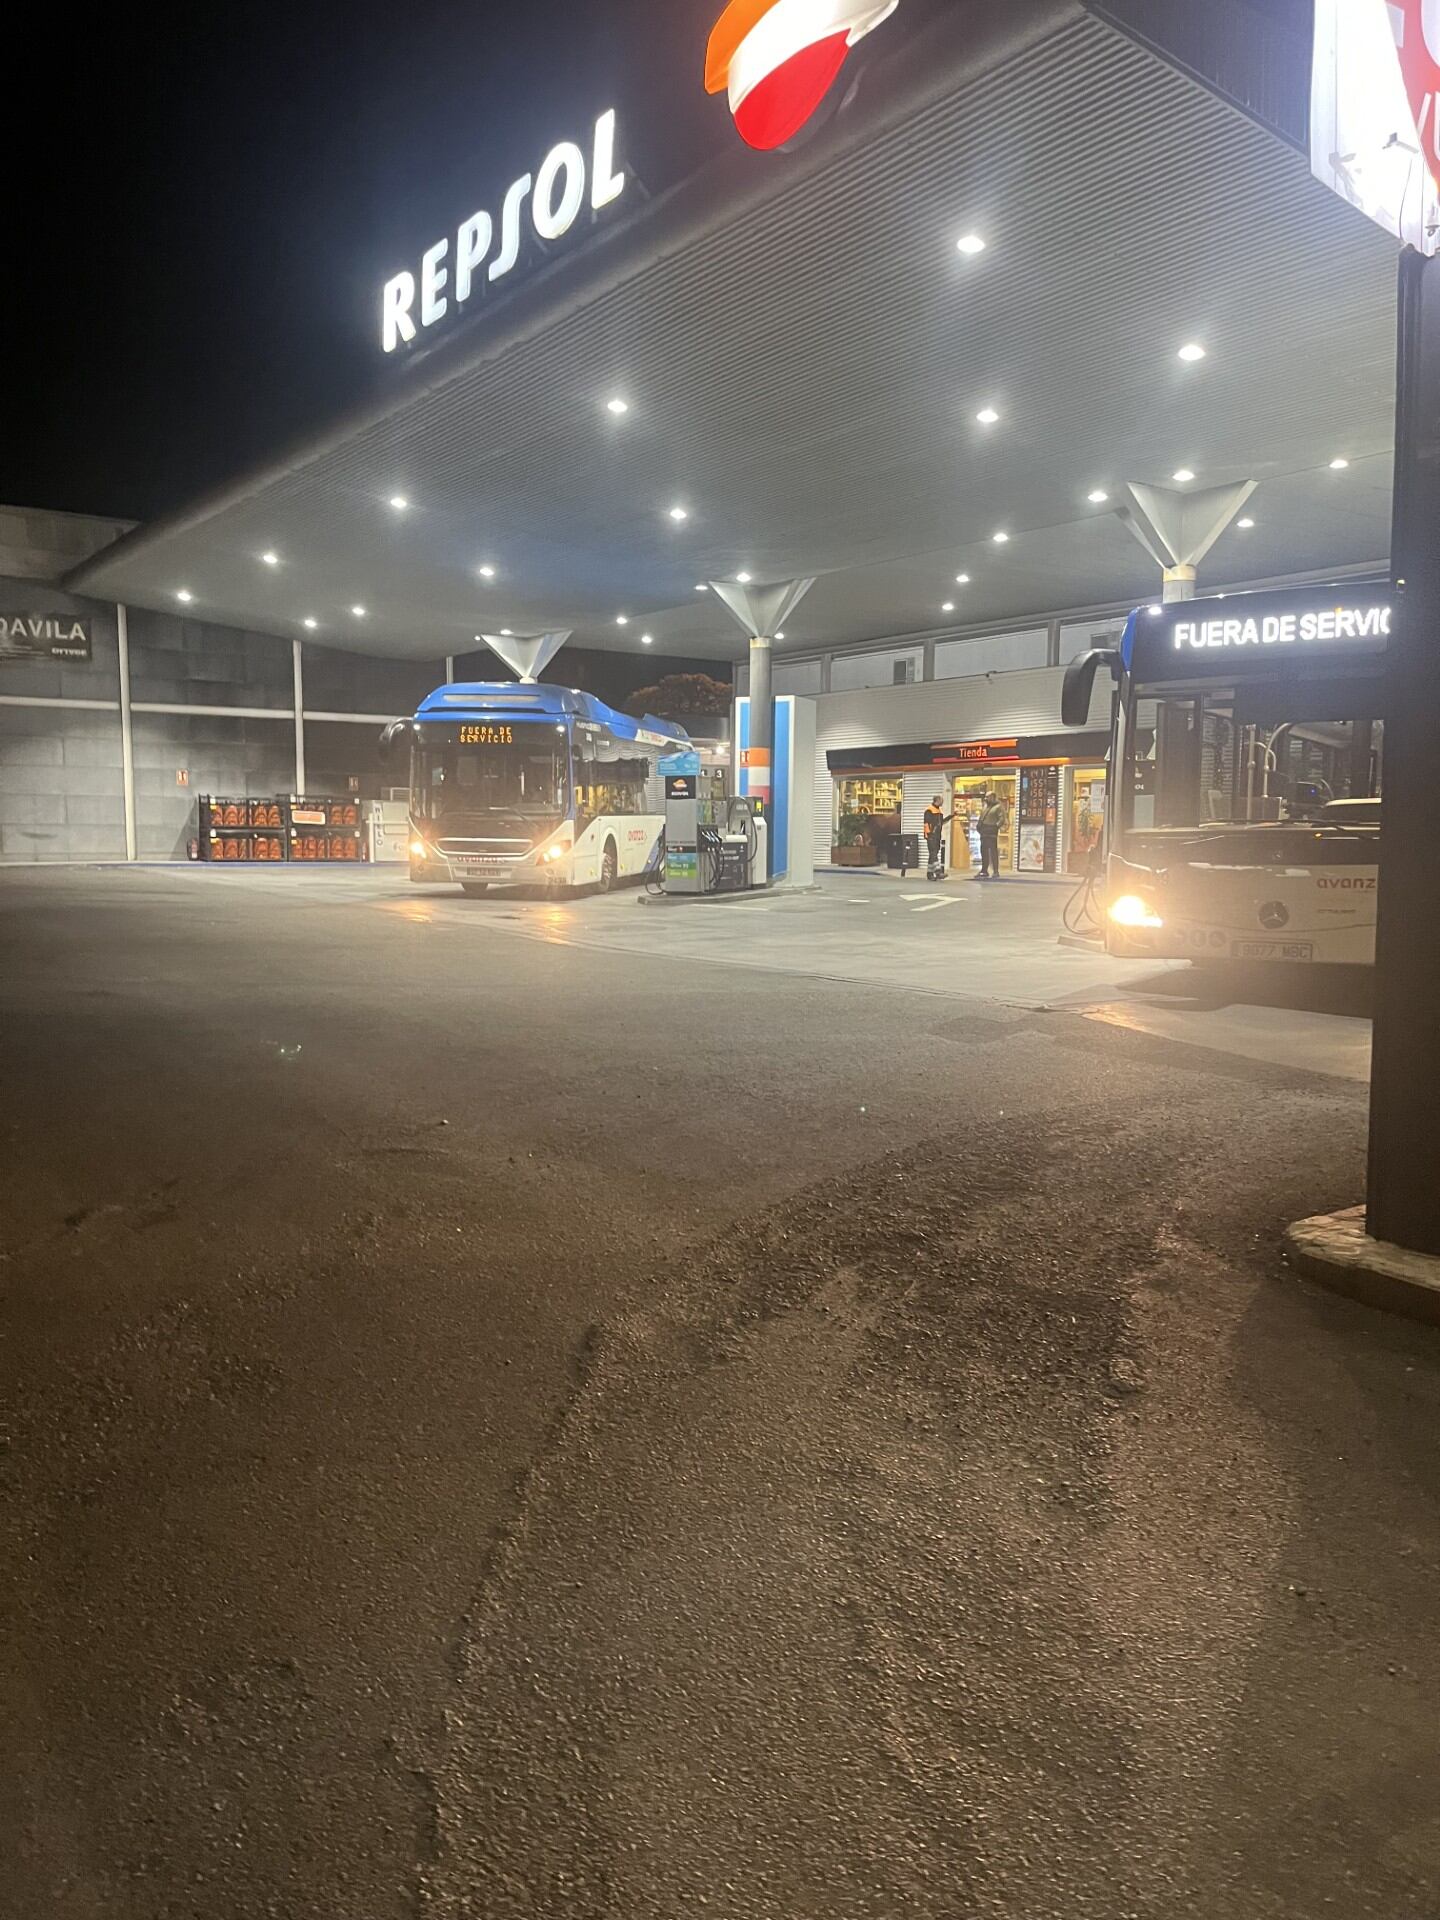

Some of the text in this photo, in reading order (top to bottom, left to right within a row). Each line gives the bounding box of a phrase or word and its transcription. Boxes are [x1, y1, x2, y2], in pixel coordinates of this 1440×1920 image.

[383, 108, 625, 353] REPSOL
[1174, 618, 1258, 650] FUERA
[1262, 614, 1297, 644] DE
[461, 726, 512, 735] FUERA DE
[460, 734, 513, 744] SERVICIO
[959, 746, 988, 758] Tienda
[716, 769, 723, 778] 3
